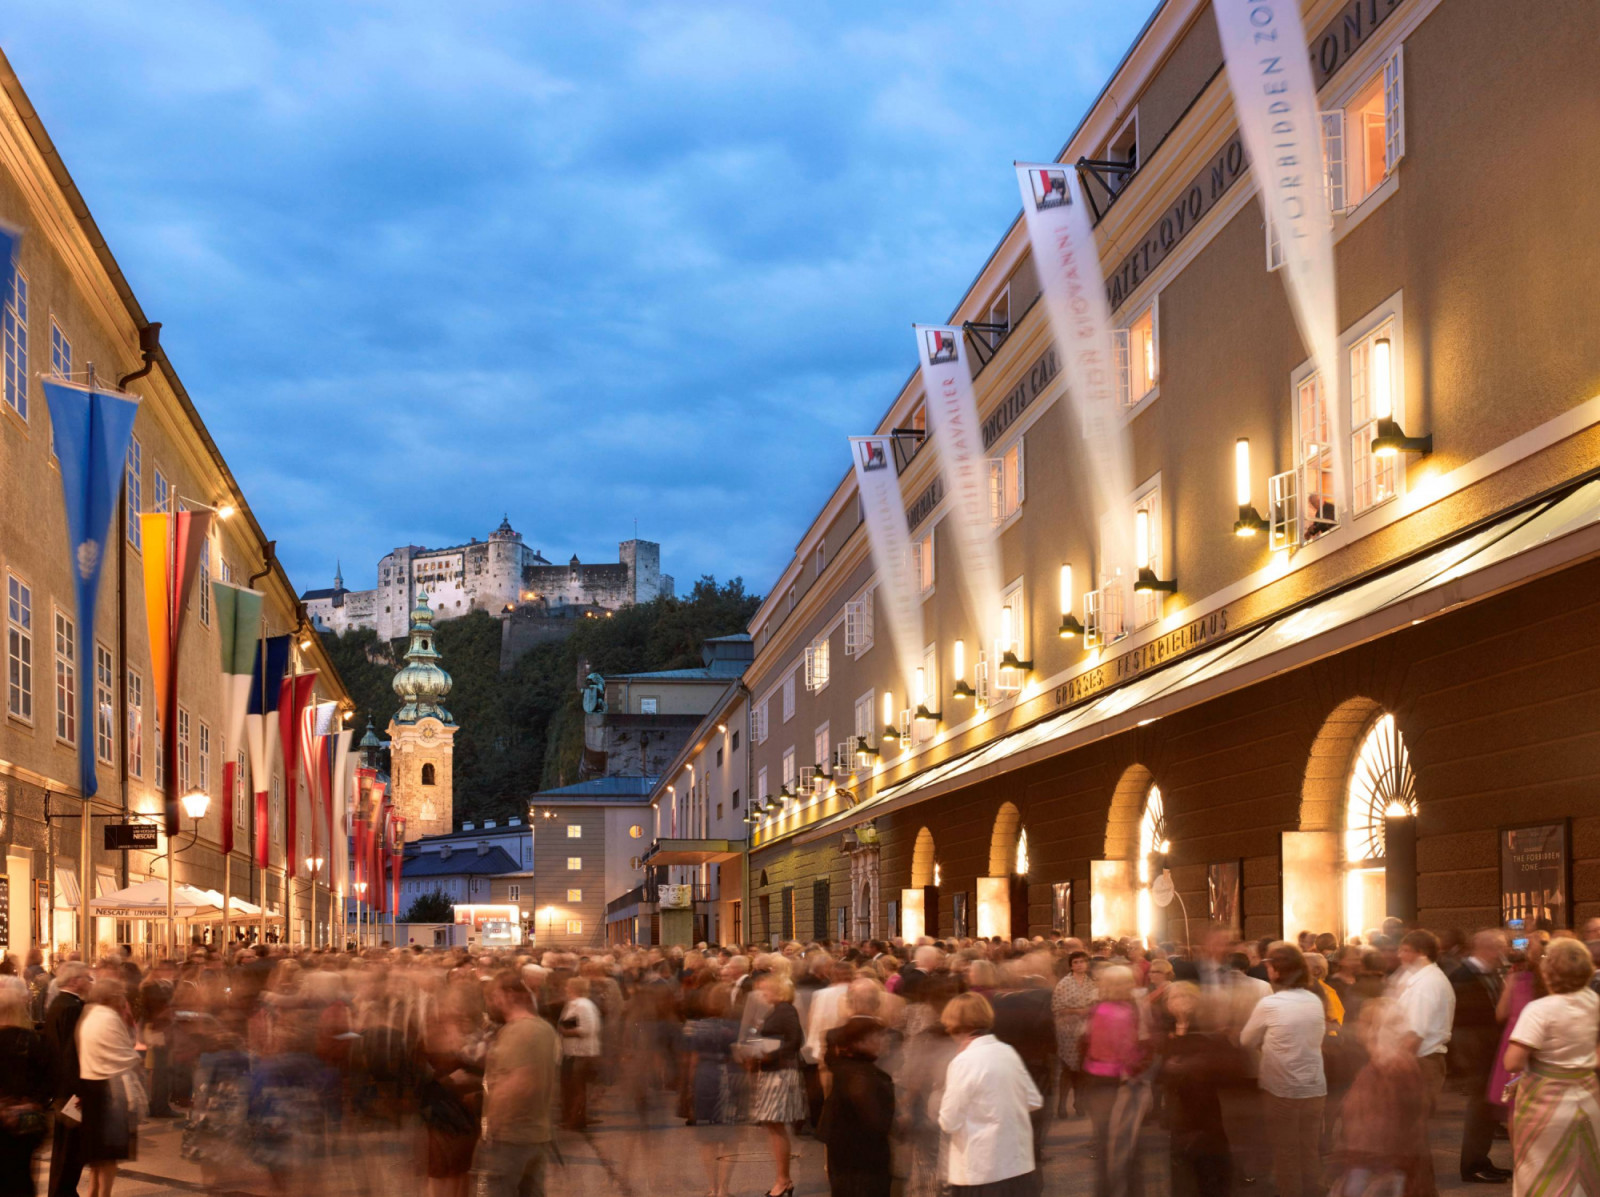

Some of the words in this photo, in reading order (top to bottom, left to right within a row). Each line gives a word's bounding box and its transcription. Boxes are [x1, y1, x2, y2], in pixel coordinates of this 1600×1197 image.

[1249, 0, 1279, 45] ZO
[982, 383, 1026, 450] ONCITIS
[1030, 350, 1061, 396] CAR
[1211, 140, 1243, 200] NO
[1056, 668, 1104, 705] GROSSES
[1117, 609, 1228, 677] FESTSPIELHAUS
